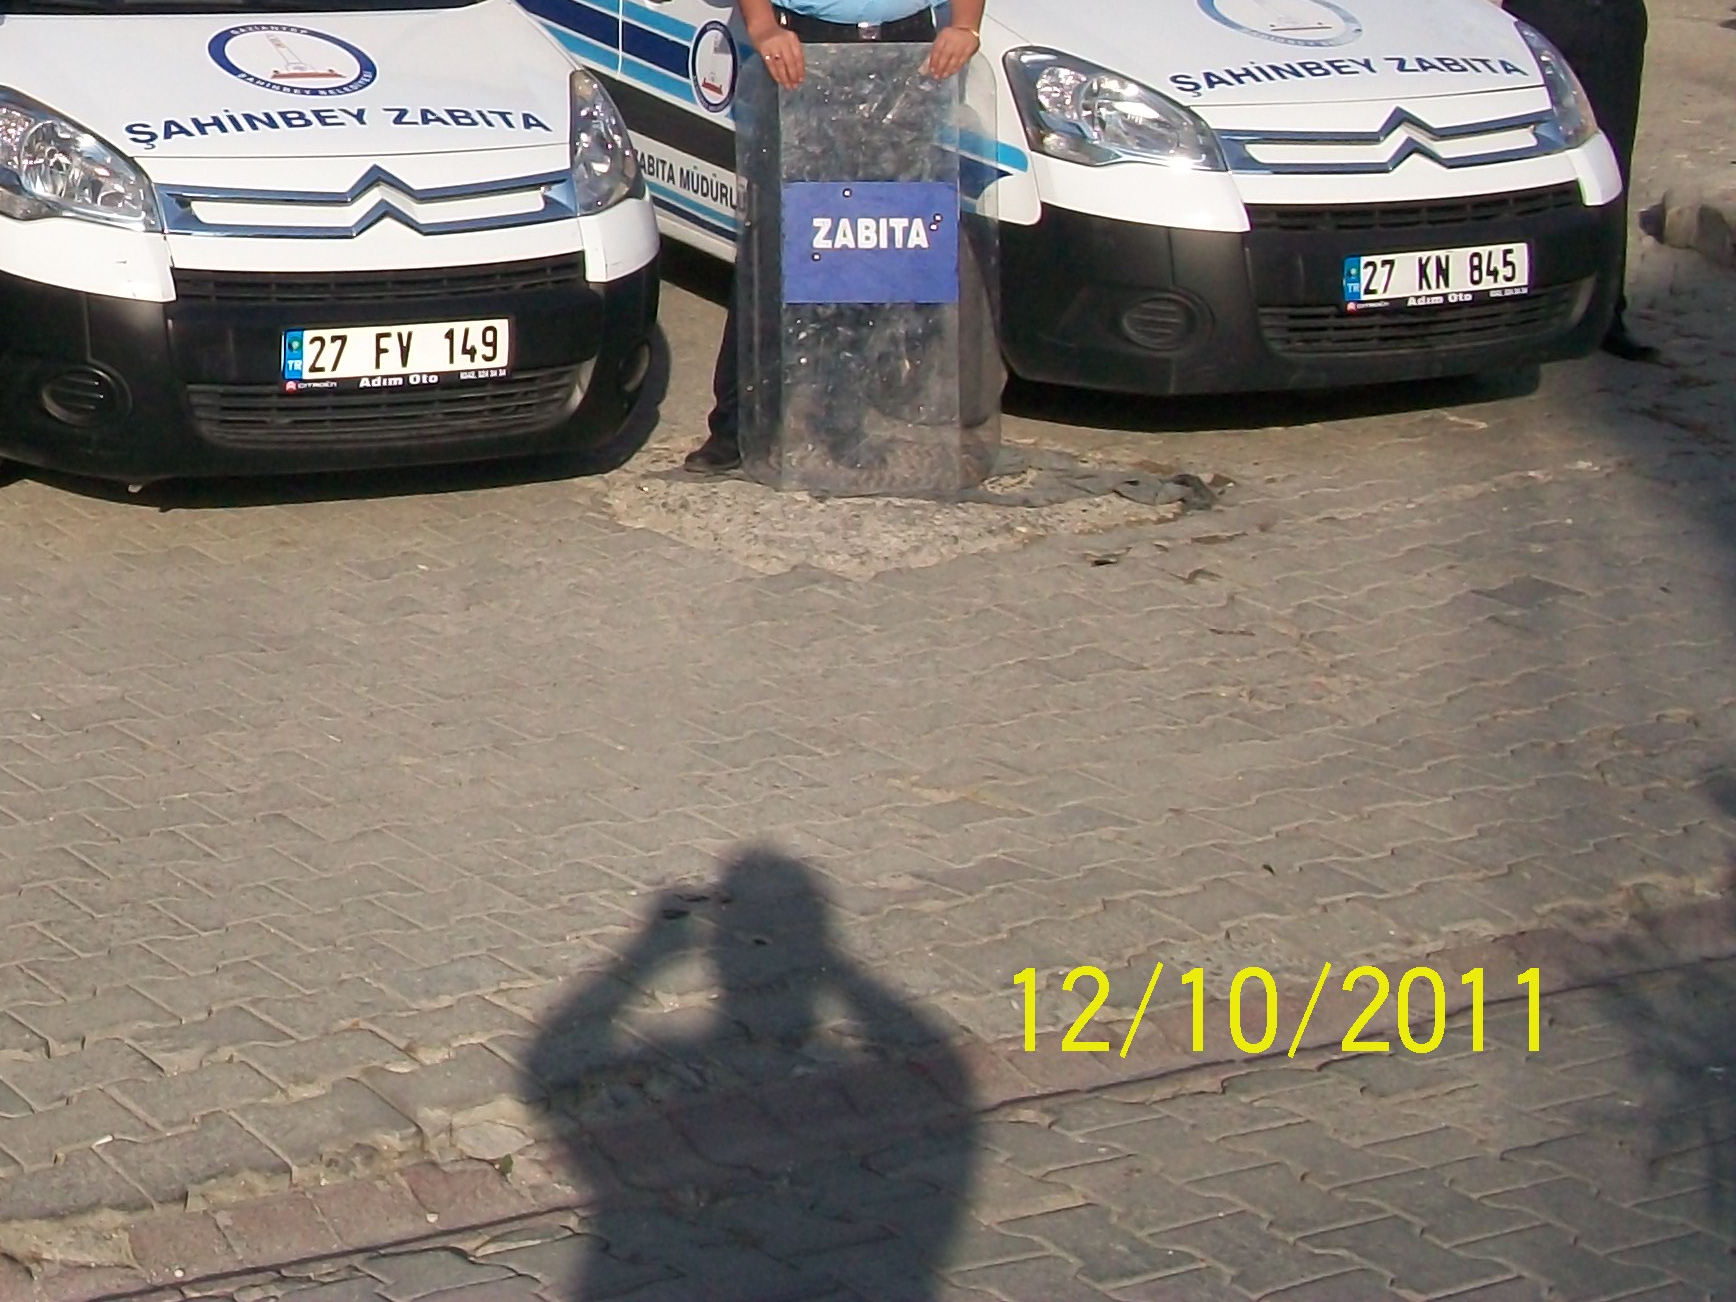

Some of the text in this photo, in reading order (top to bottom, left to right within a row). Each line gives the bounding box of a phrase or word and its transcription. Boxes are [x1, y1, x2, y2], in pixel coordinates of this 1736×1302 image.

[1169, 57, 1529, 98] ŞAHİNBEY ZABITA
[124, 107, 553, 150] ŞAHİNBEY ZABITA
[812, 217, 930, 248] ZABITA
[1364, 248, 1516, 295] 27 KN 845
[1448, 293, 1472, 302] Oto
[288, 360, 302, 371] TR
[308, 325, 498, 373] 27 FV 149
[409, 373, 439, 385] Oto
